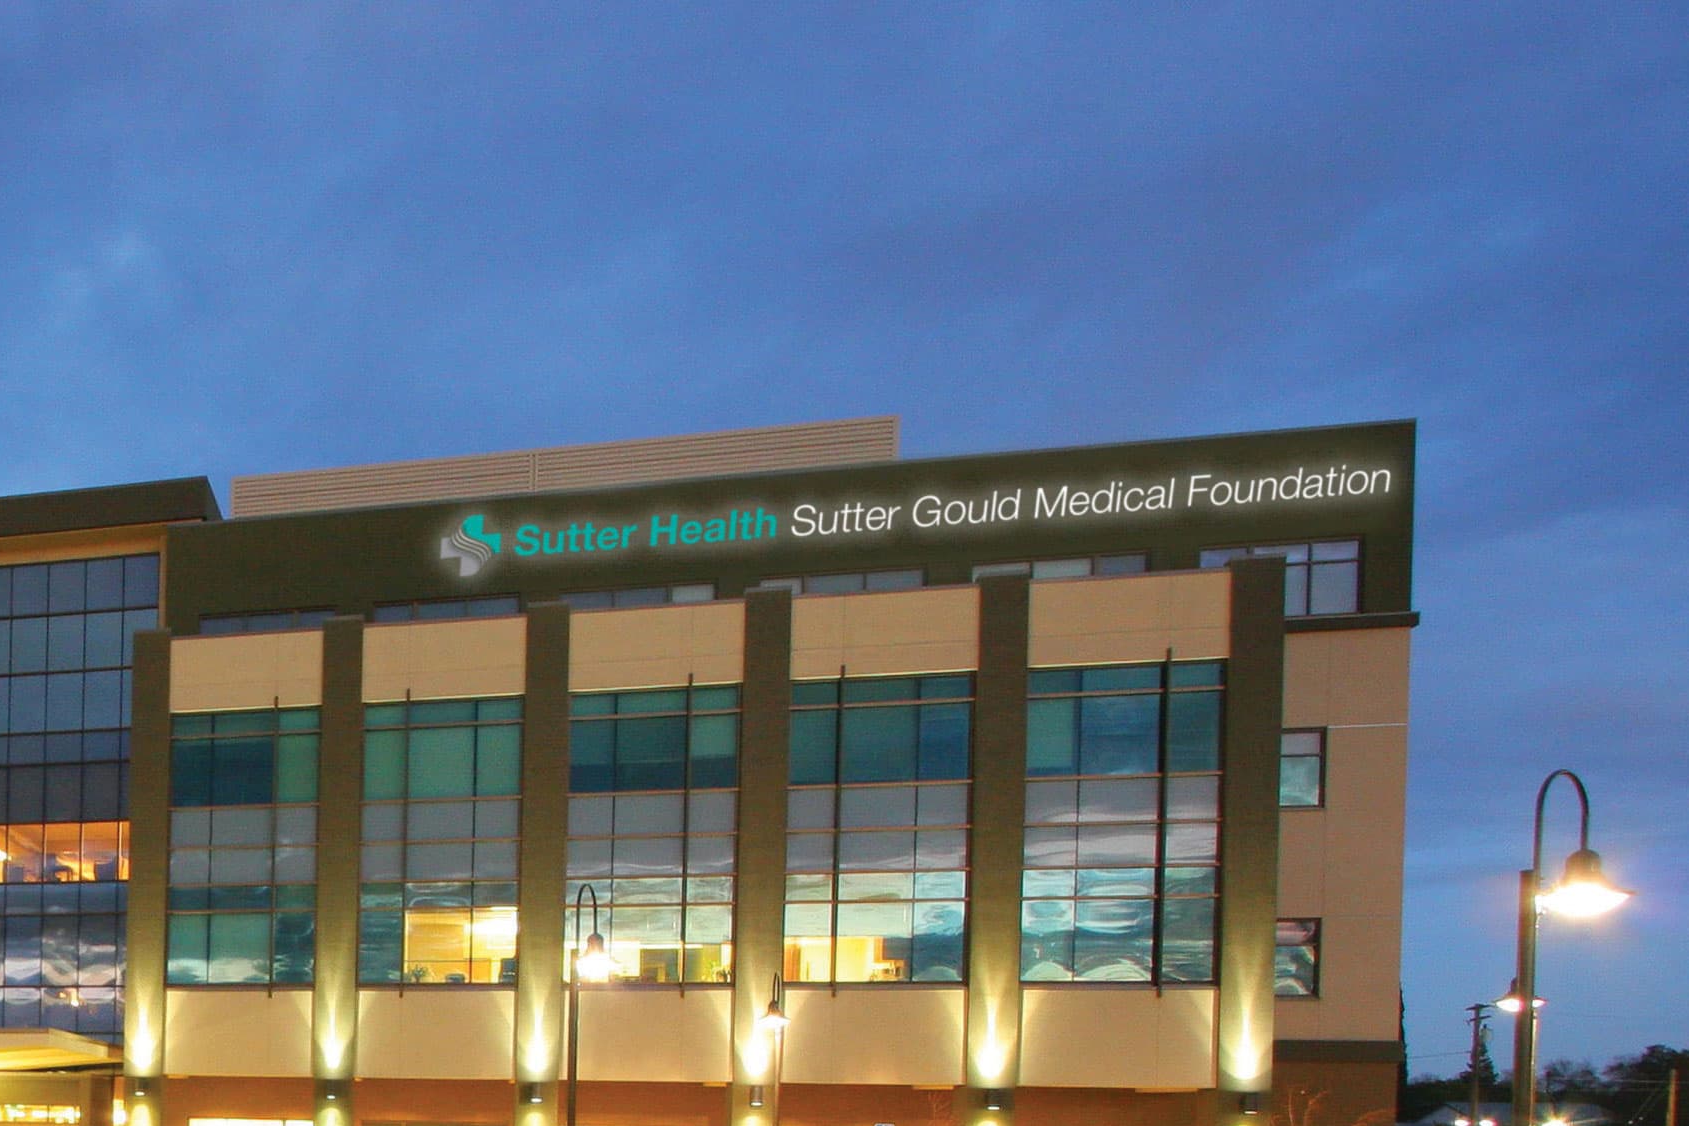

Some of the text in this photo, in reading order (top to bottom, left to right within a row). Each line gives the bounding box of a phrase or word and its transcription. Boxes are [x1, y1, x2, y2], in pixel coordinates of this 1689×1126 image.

[514, 464, 1391, 556] Sutter Health Sutter Gould Medical Foundation
